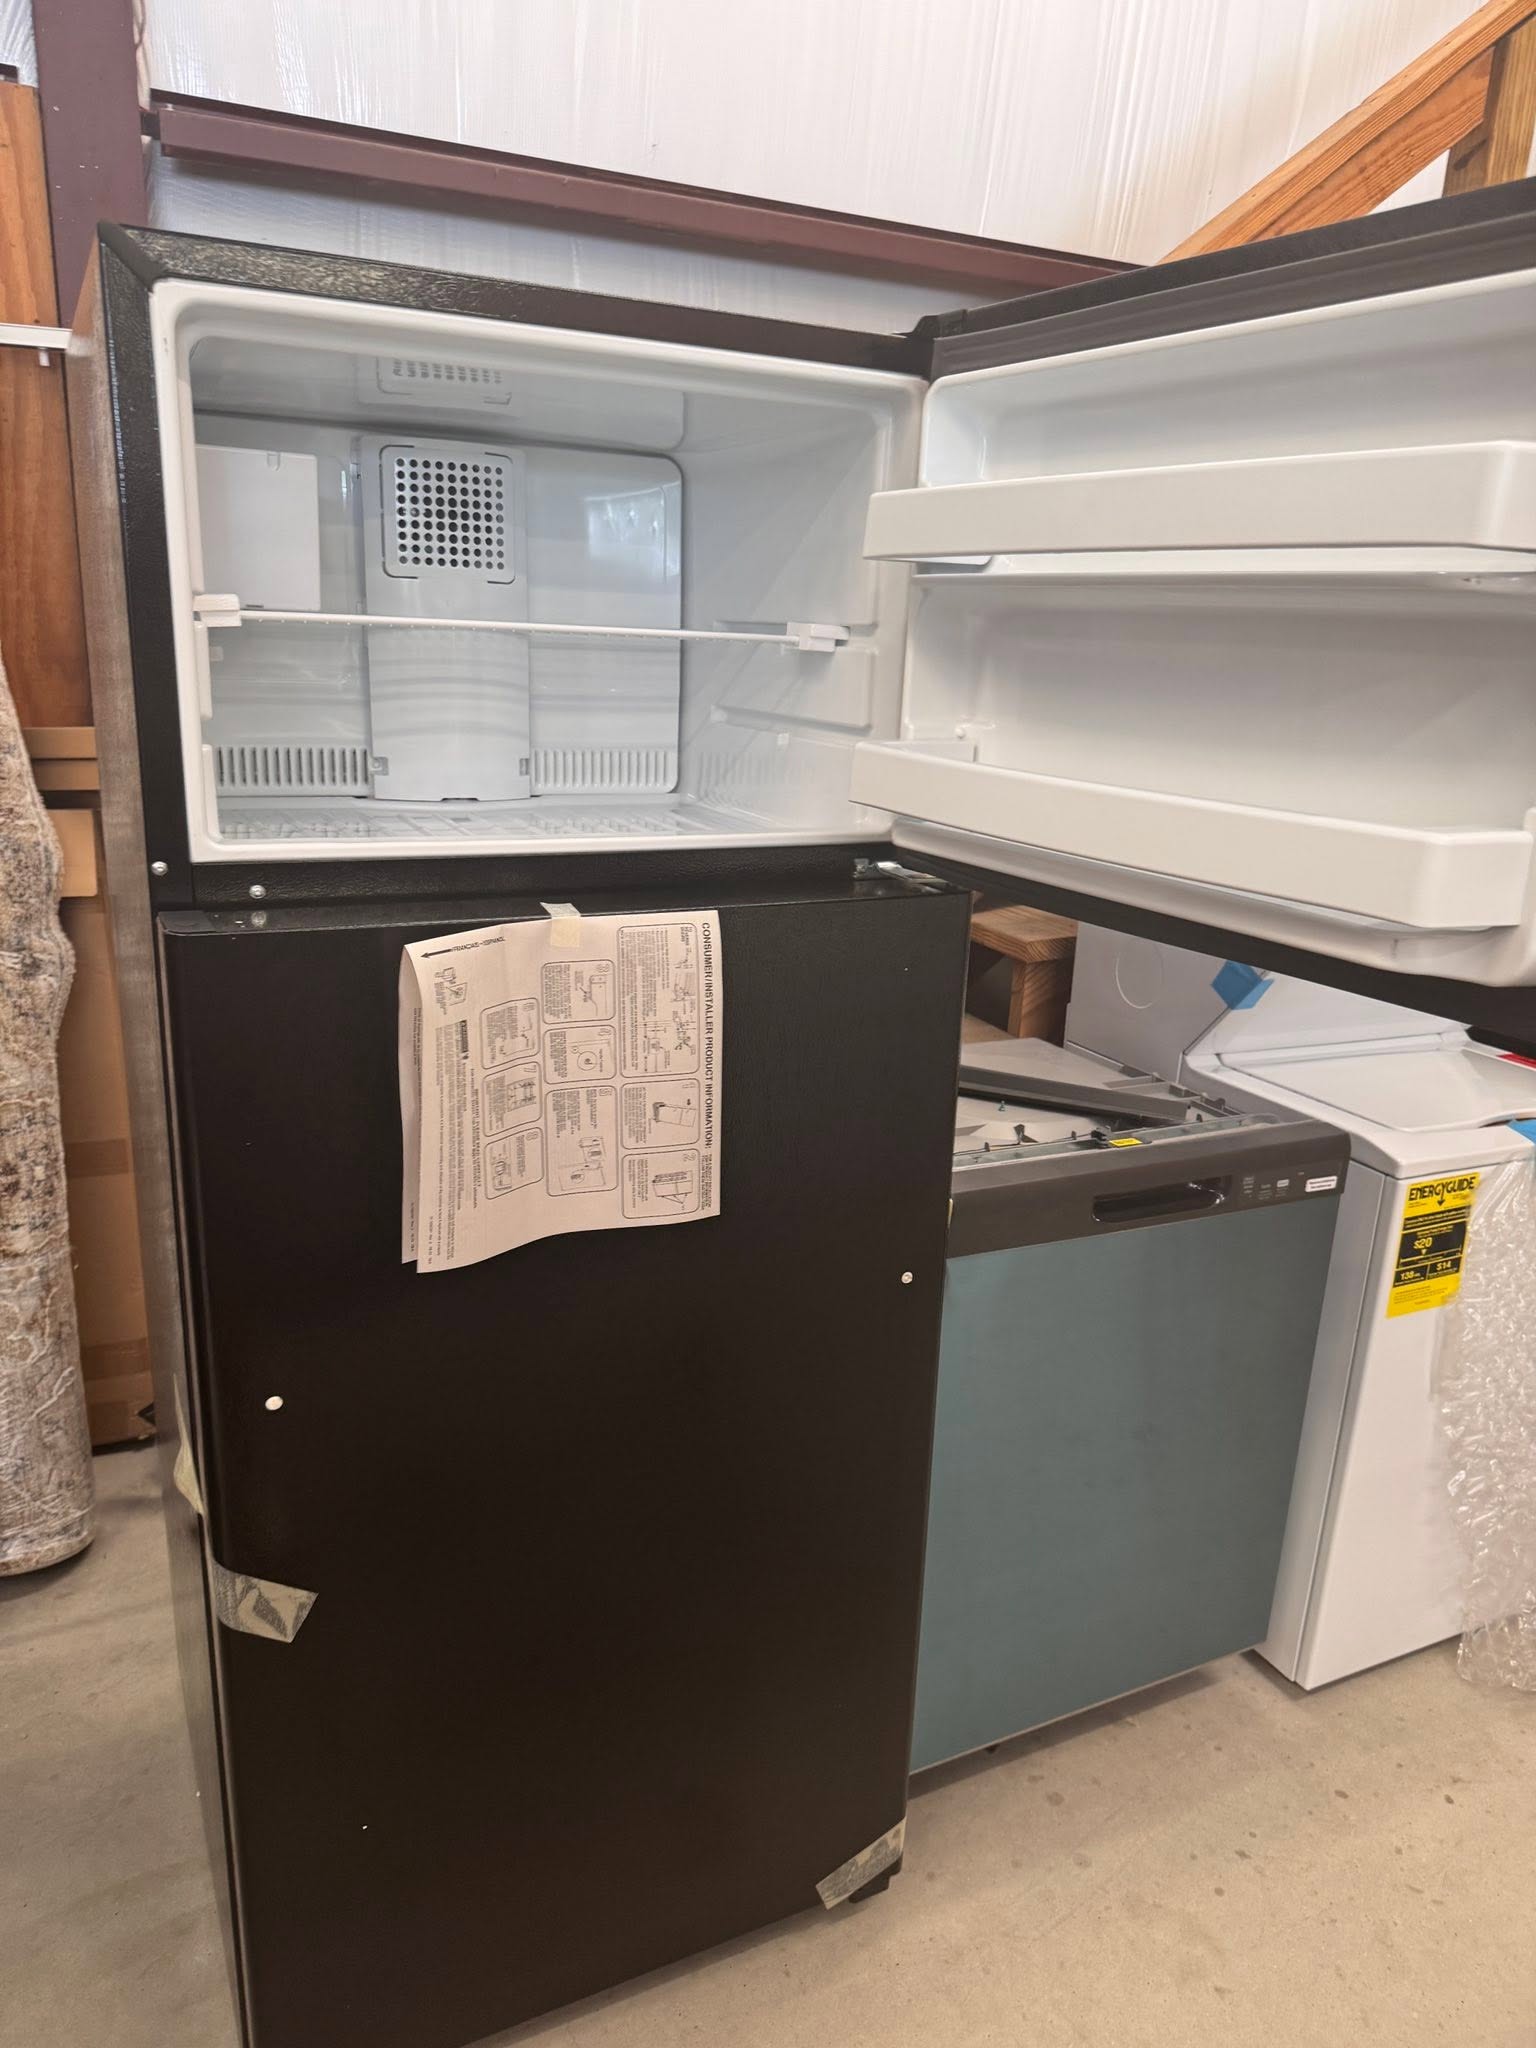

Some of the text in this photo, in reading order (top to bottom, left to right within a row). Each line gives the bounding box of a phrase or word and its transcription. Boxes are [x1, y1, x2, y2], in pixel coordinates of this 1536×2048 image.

[702, 922, 714, 1035] CONSUMER/INSTALLER
[704, 1037, 714, 1081] PRODUCT
[704, 1083, 714, 1150] INFORMATION:
